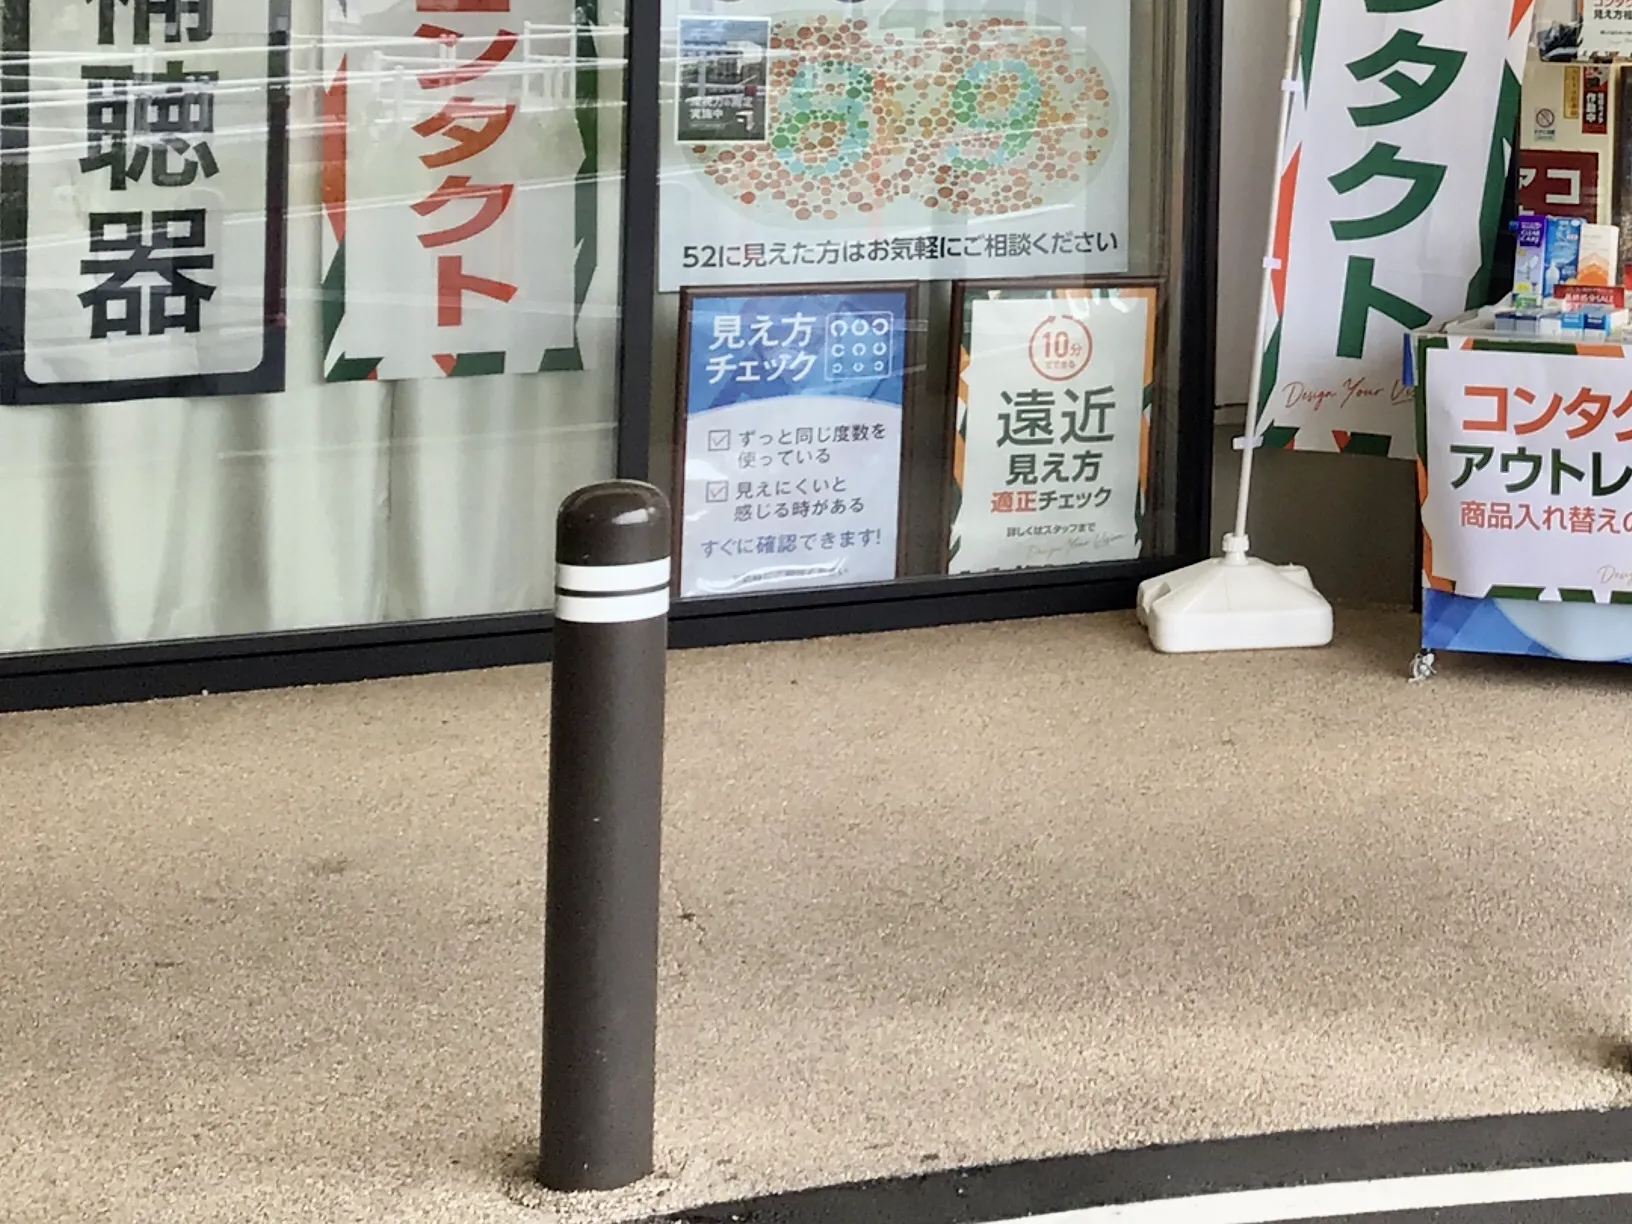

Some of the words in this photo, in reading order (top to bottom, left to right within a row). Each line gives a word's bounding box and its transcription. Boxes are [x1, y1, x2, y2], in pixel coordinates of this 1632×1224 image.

[682, 231, 1118, 269] 52に見えた方はお気軽にご相談ください
[708, 312, 817, 350] 見え方
[705, 352, 817, 384] チェック
[1282, 380, 1337, 411] Design
[1340, 377, 1385, 409] Your
[996, 385, 1116, 448] 遠近
[738, 423, 886, 448] ずっと同じ度数を
[738, 448, 831, 468] 使っている
[1006, 450, 1103, 485] 見え方
[735, 477, 847, 499] 見えにくいと
[991, 486, 1112, 513] 適正チェック
[733, 497, 865, 523] 感じる時がある
[702, 528, 882, 558] すぐに確認できます!
